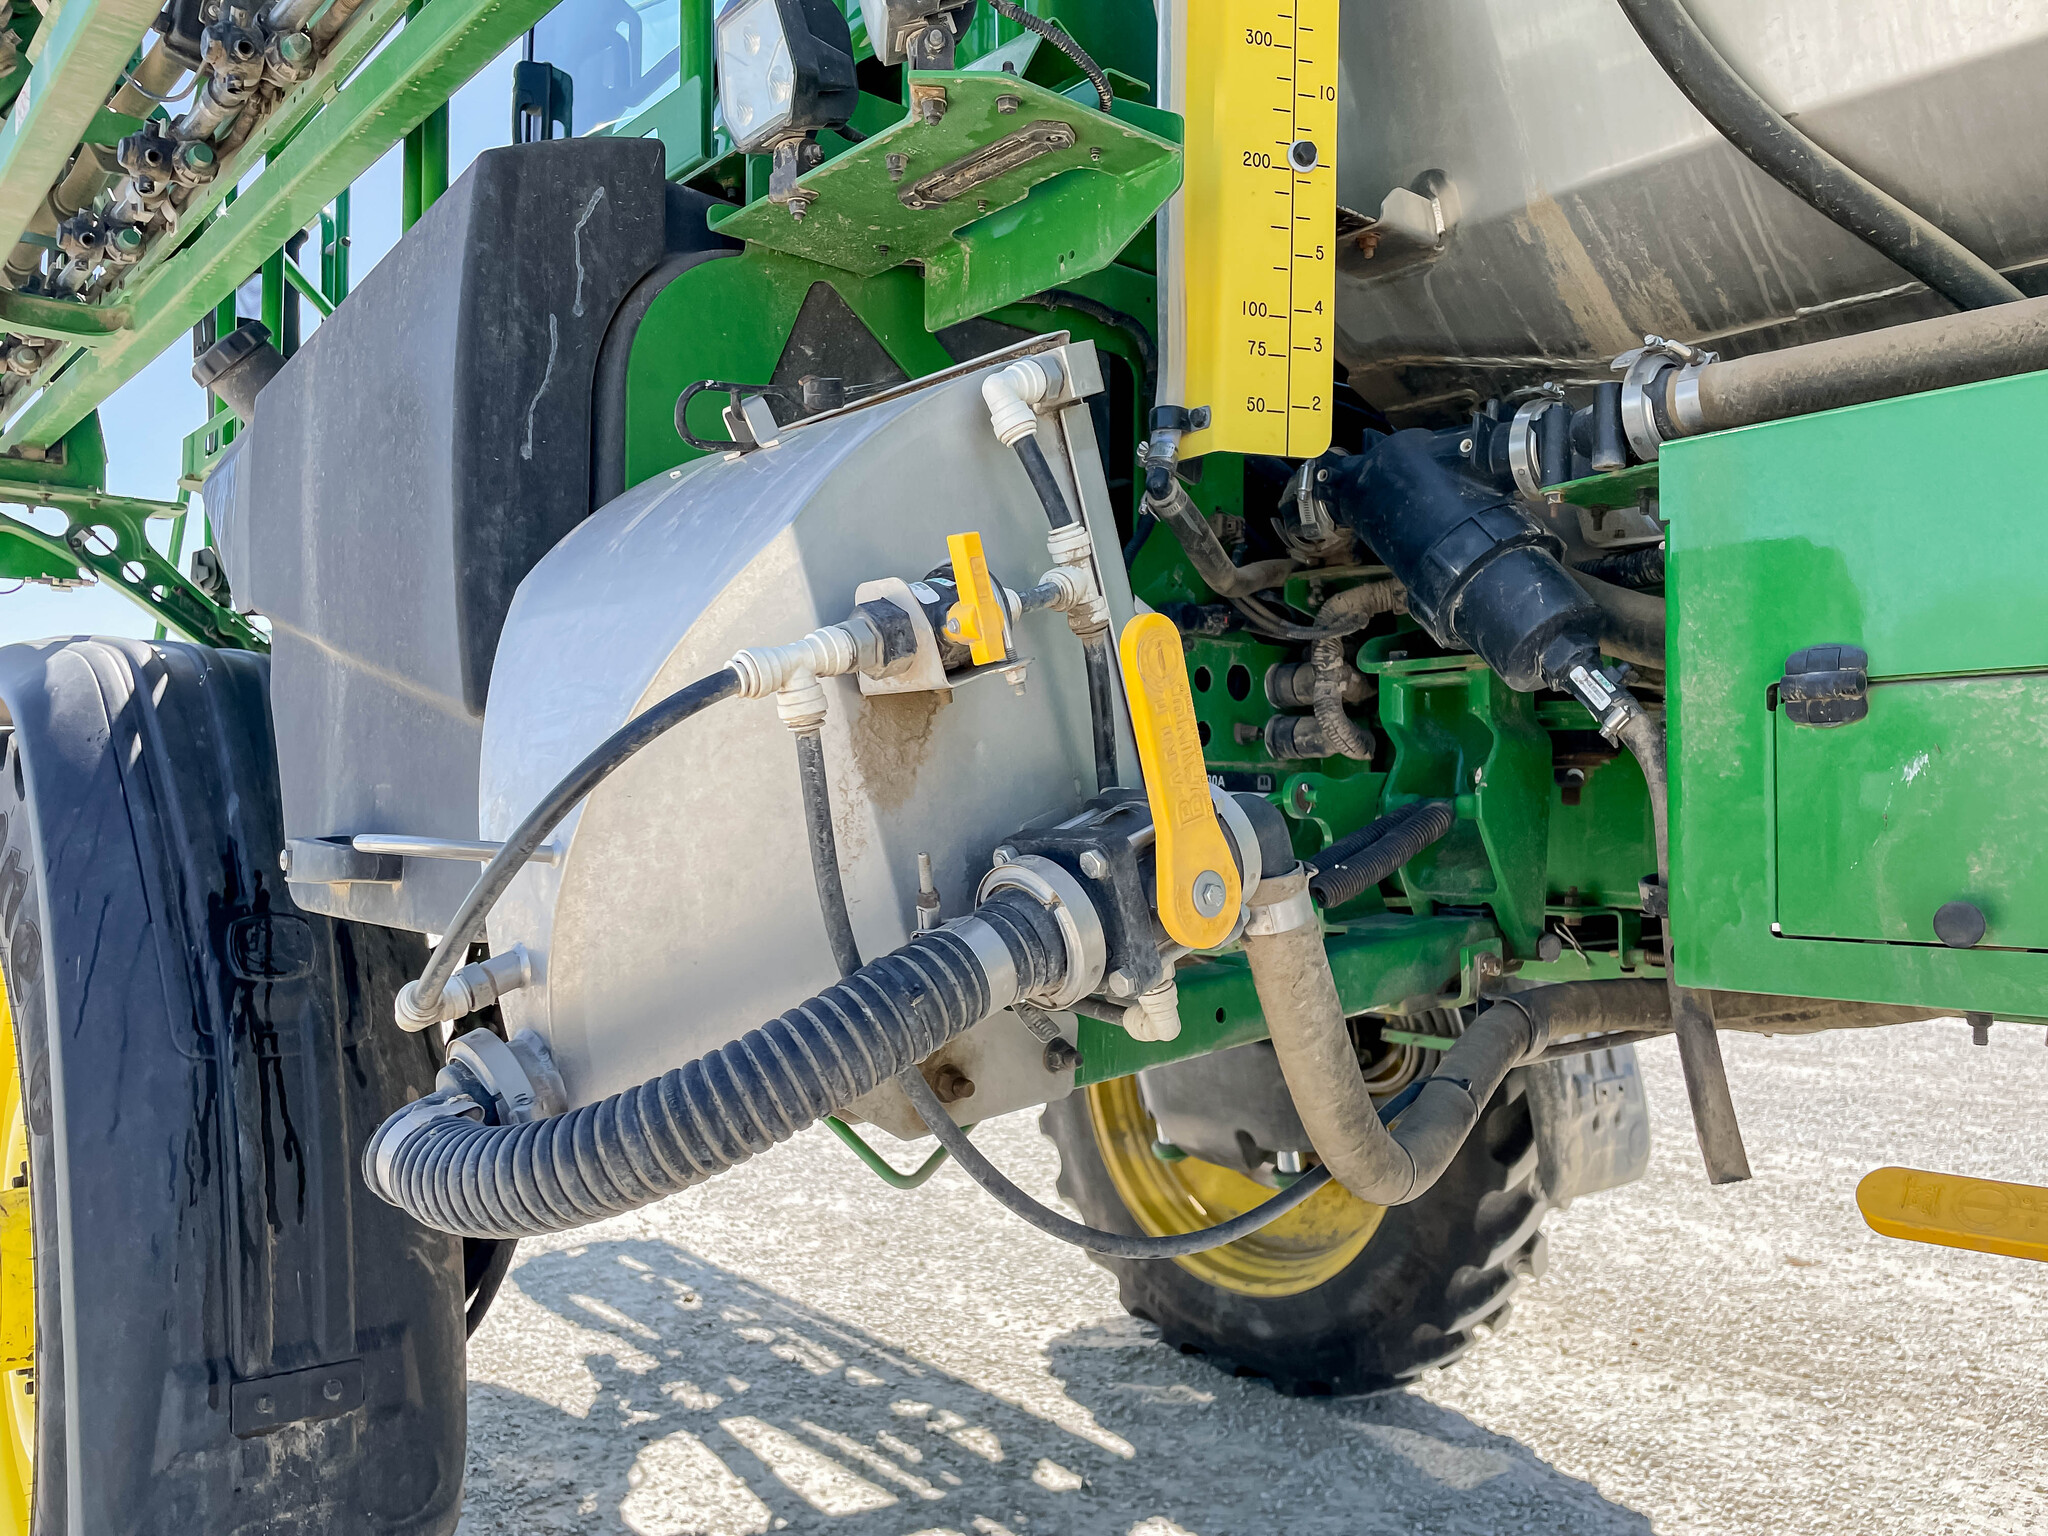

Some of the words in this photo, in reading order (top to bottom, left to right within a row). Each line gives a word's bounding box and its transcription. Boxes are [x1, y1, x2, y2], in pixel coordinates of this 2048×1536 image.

[1245, 28, 1272, 46] 300
[1320, 85, 1335, 101] 10
[1242, 150, 1270, 168] 200
[1315, 245, 1325, 260] 5
[1242, 300, 1267, 317] 100
[1314, 300, 1324, 315] 4
[1247, 339, 1266, 356] 75
[1313, 336, 1323, 352] 3
[1246, 396, 1265, 412] 50
[1312, 395, 1322, 411] 2
